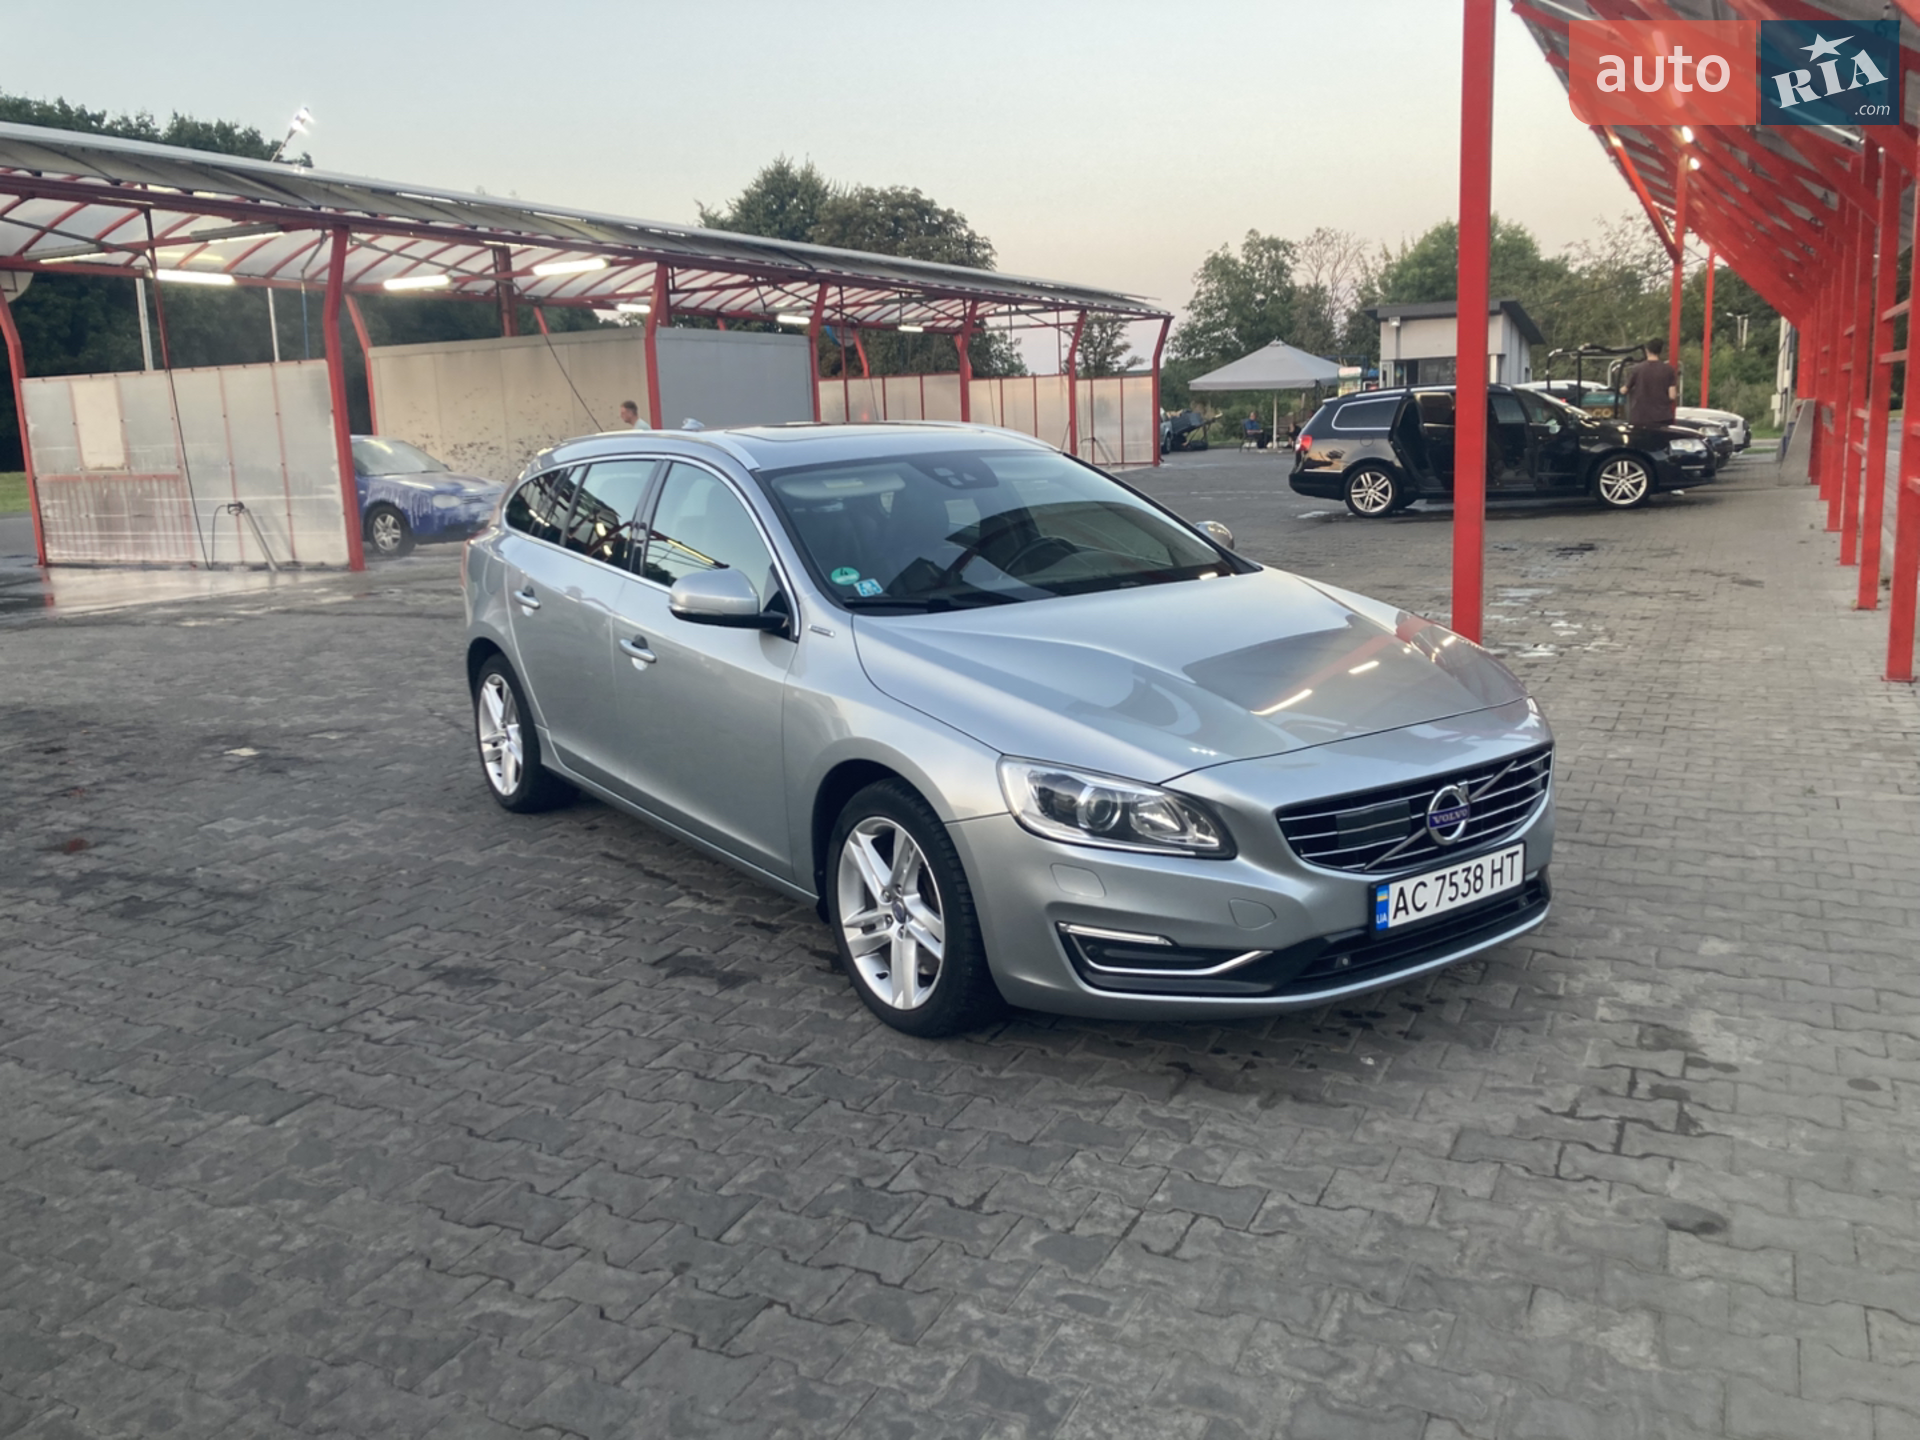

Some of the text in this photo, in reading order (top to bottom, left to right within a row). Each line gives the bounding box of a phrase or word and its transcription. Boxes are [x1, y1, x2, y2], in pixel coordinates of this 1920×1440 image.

[1432, 807, 1468, 825] VOLVO
[1392, 850, 1520, 920] AC 7538 HT
[1376, 912, 1388, 925] UA
